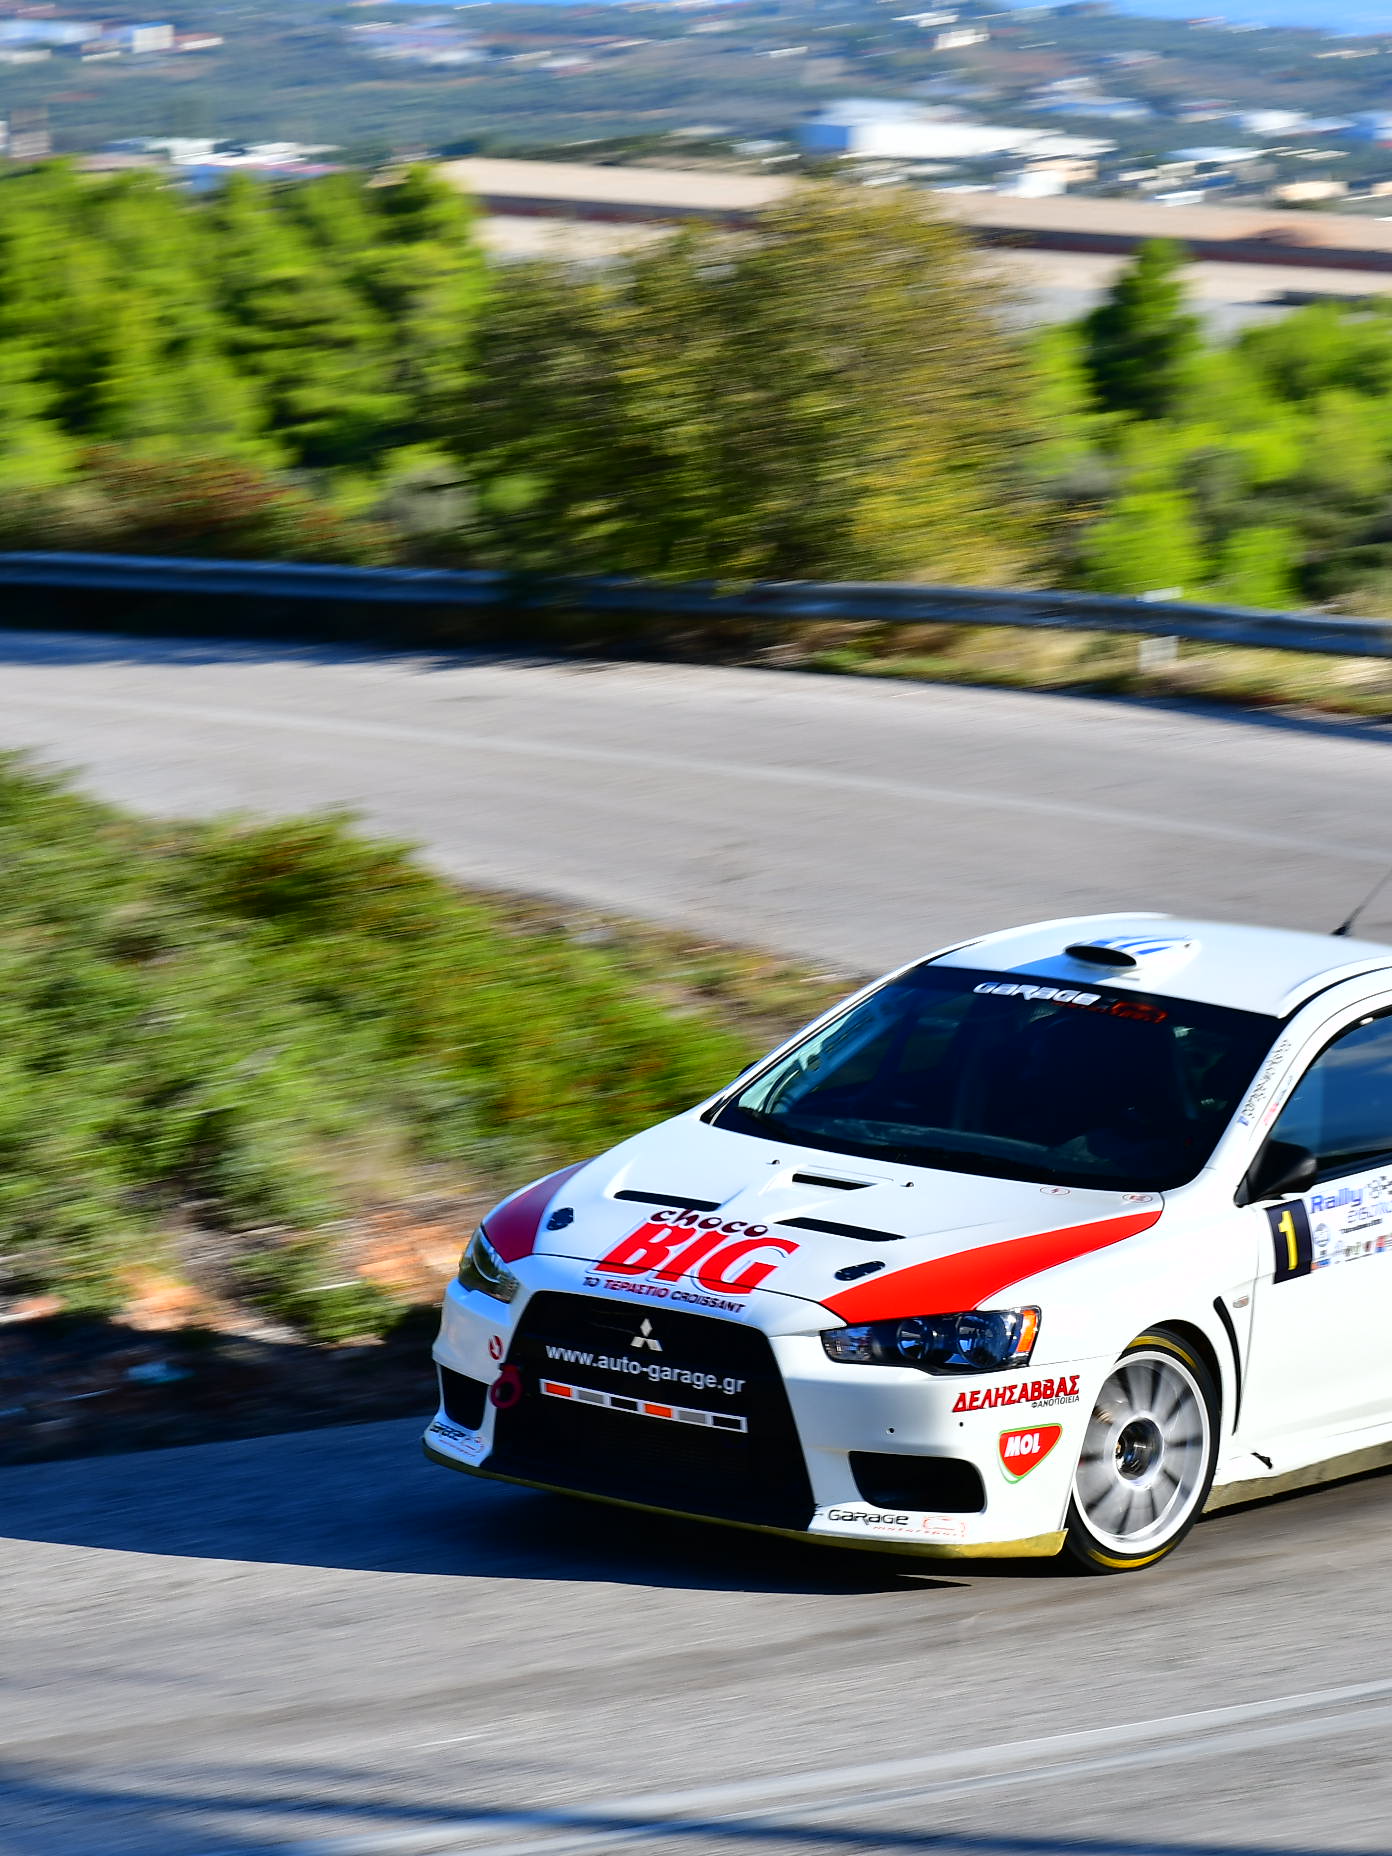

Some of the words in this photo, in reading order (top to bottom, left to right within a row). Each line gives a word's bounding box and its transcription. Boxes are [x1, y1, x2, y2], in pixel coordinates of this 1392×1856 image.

[1311, 1187, 1364, 1213] Rally
[650, 1208, 769, 1237] choco
[1278, 1210, 1299, 1270] 1
[594, 1222, 801, 1294] BIG
[670, 1290, 746, 1313] CROISSANT
[546, 1345, 746, 1395] www.auto-garage.gr
[952, 1375, 1080, 1412] ΔΕΛΗΣΑΒΒΑΣ
[1004, 1433, 1040, 1457] MOL
